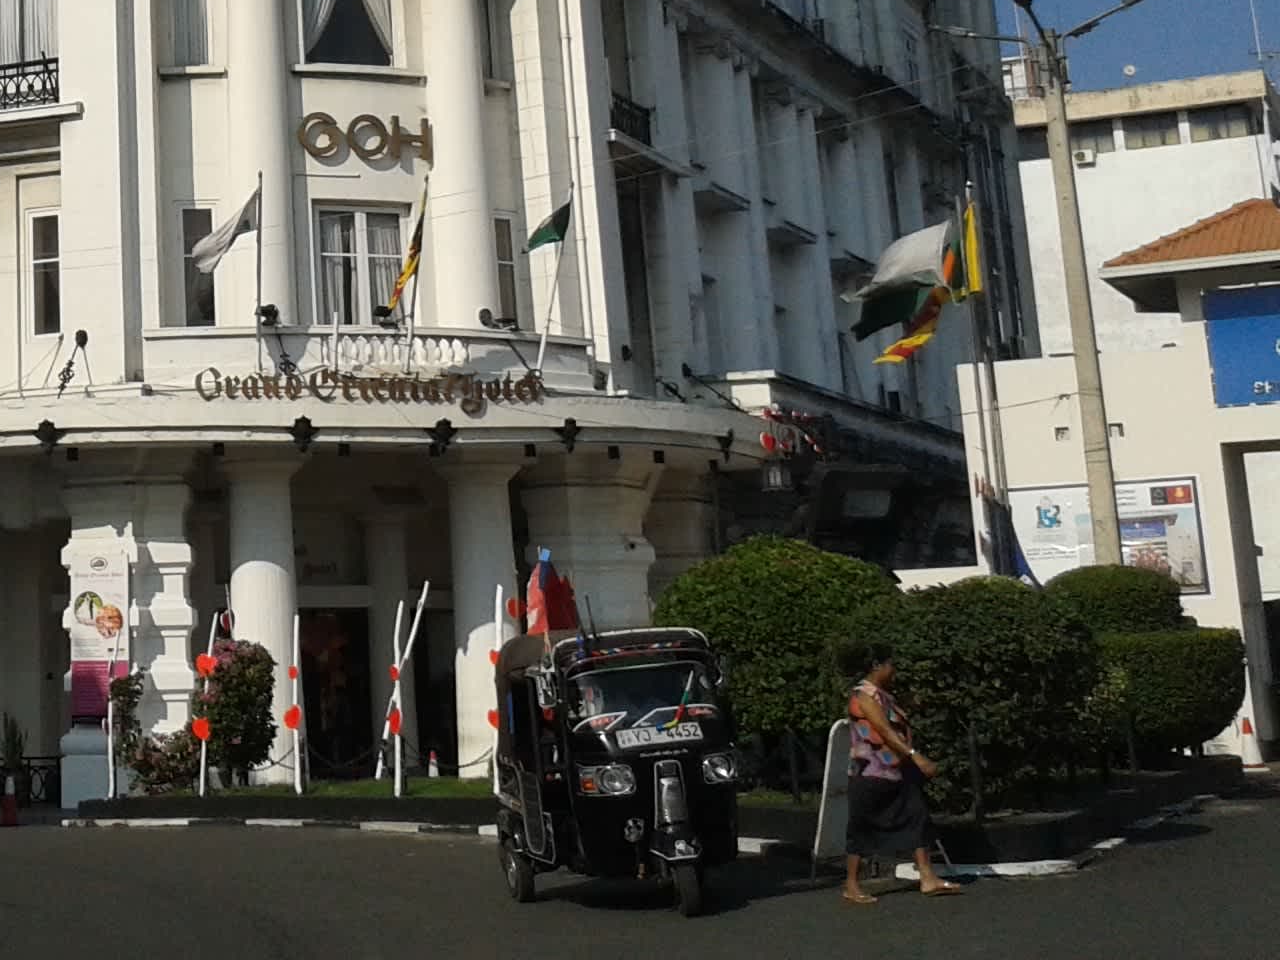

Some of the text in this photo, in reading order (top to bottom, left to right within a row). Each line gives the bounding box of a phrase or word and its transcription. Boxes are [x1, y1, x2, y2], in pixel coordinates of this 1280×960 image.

[297, 111, 433, 161] GOH
[194, 366, 303, 402] Grand
[666, 723, 701, 739] 4452
